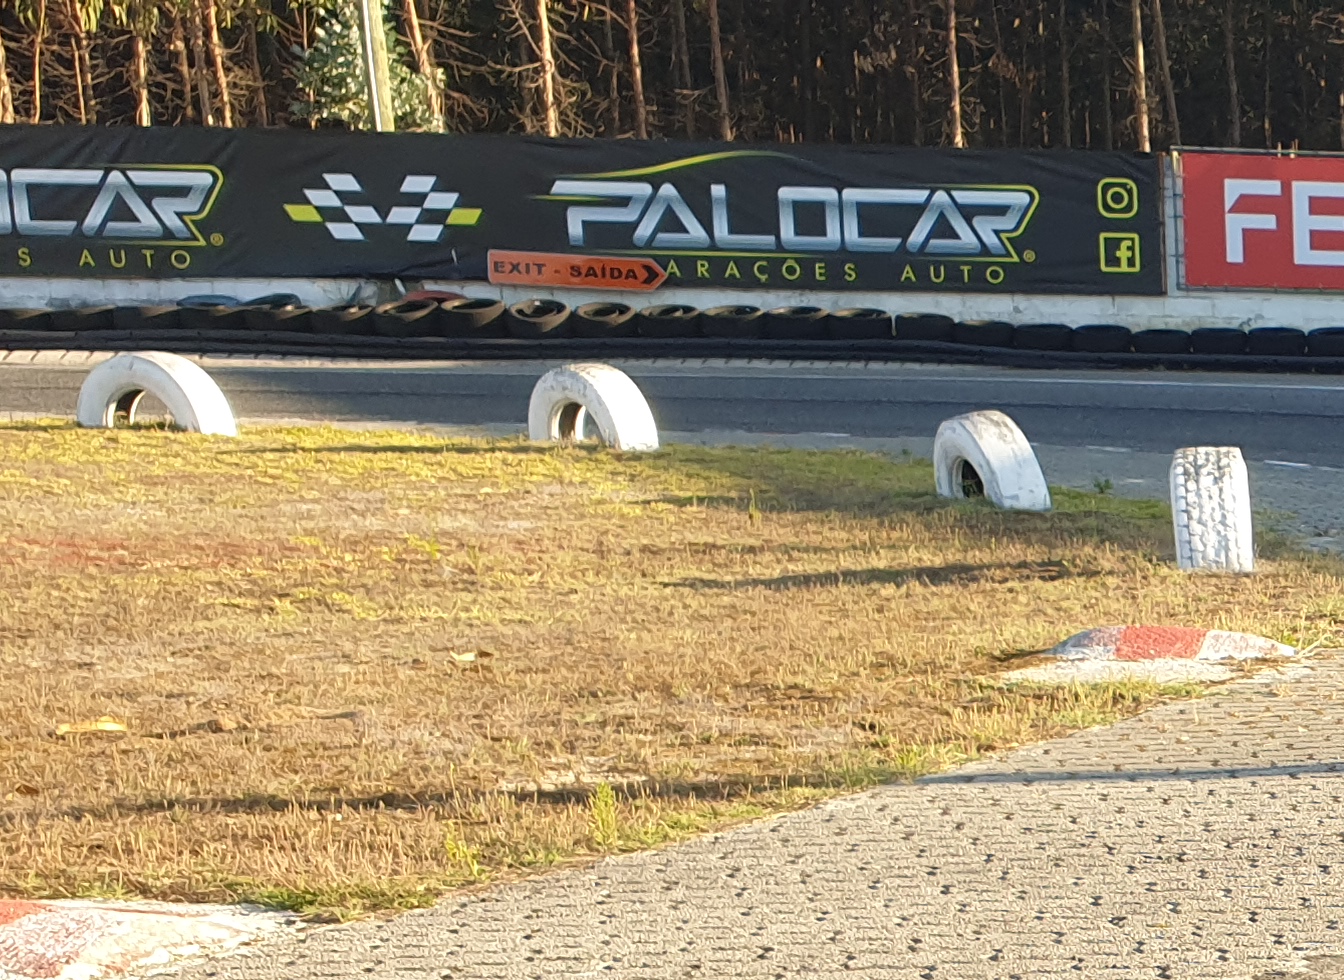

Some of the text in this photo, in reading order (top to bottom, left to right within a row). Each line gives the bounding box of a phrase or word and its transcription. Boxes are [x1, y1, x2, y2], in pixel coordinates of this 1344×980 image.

[0, 167, 214, 239] CAR
[549, 178, 1031, 254] PALOCAR
[79, 248, 192, 270] AUTO
[493, 260, 546, 275] EXIT
[569, 264, 639, 281] SAÍDA
[665, 257, 1006, 285] ARAÇÕES AUTO
